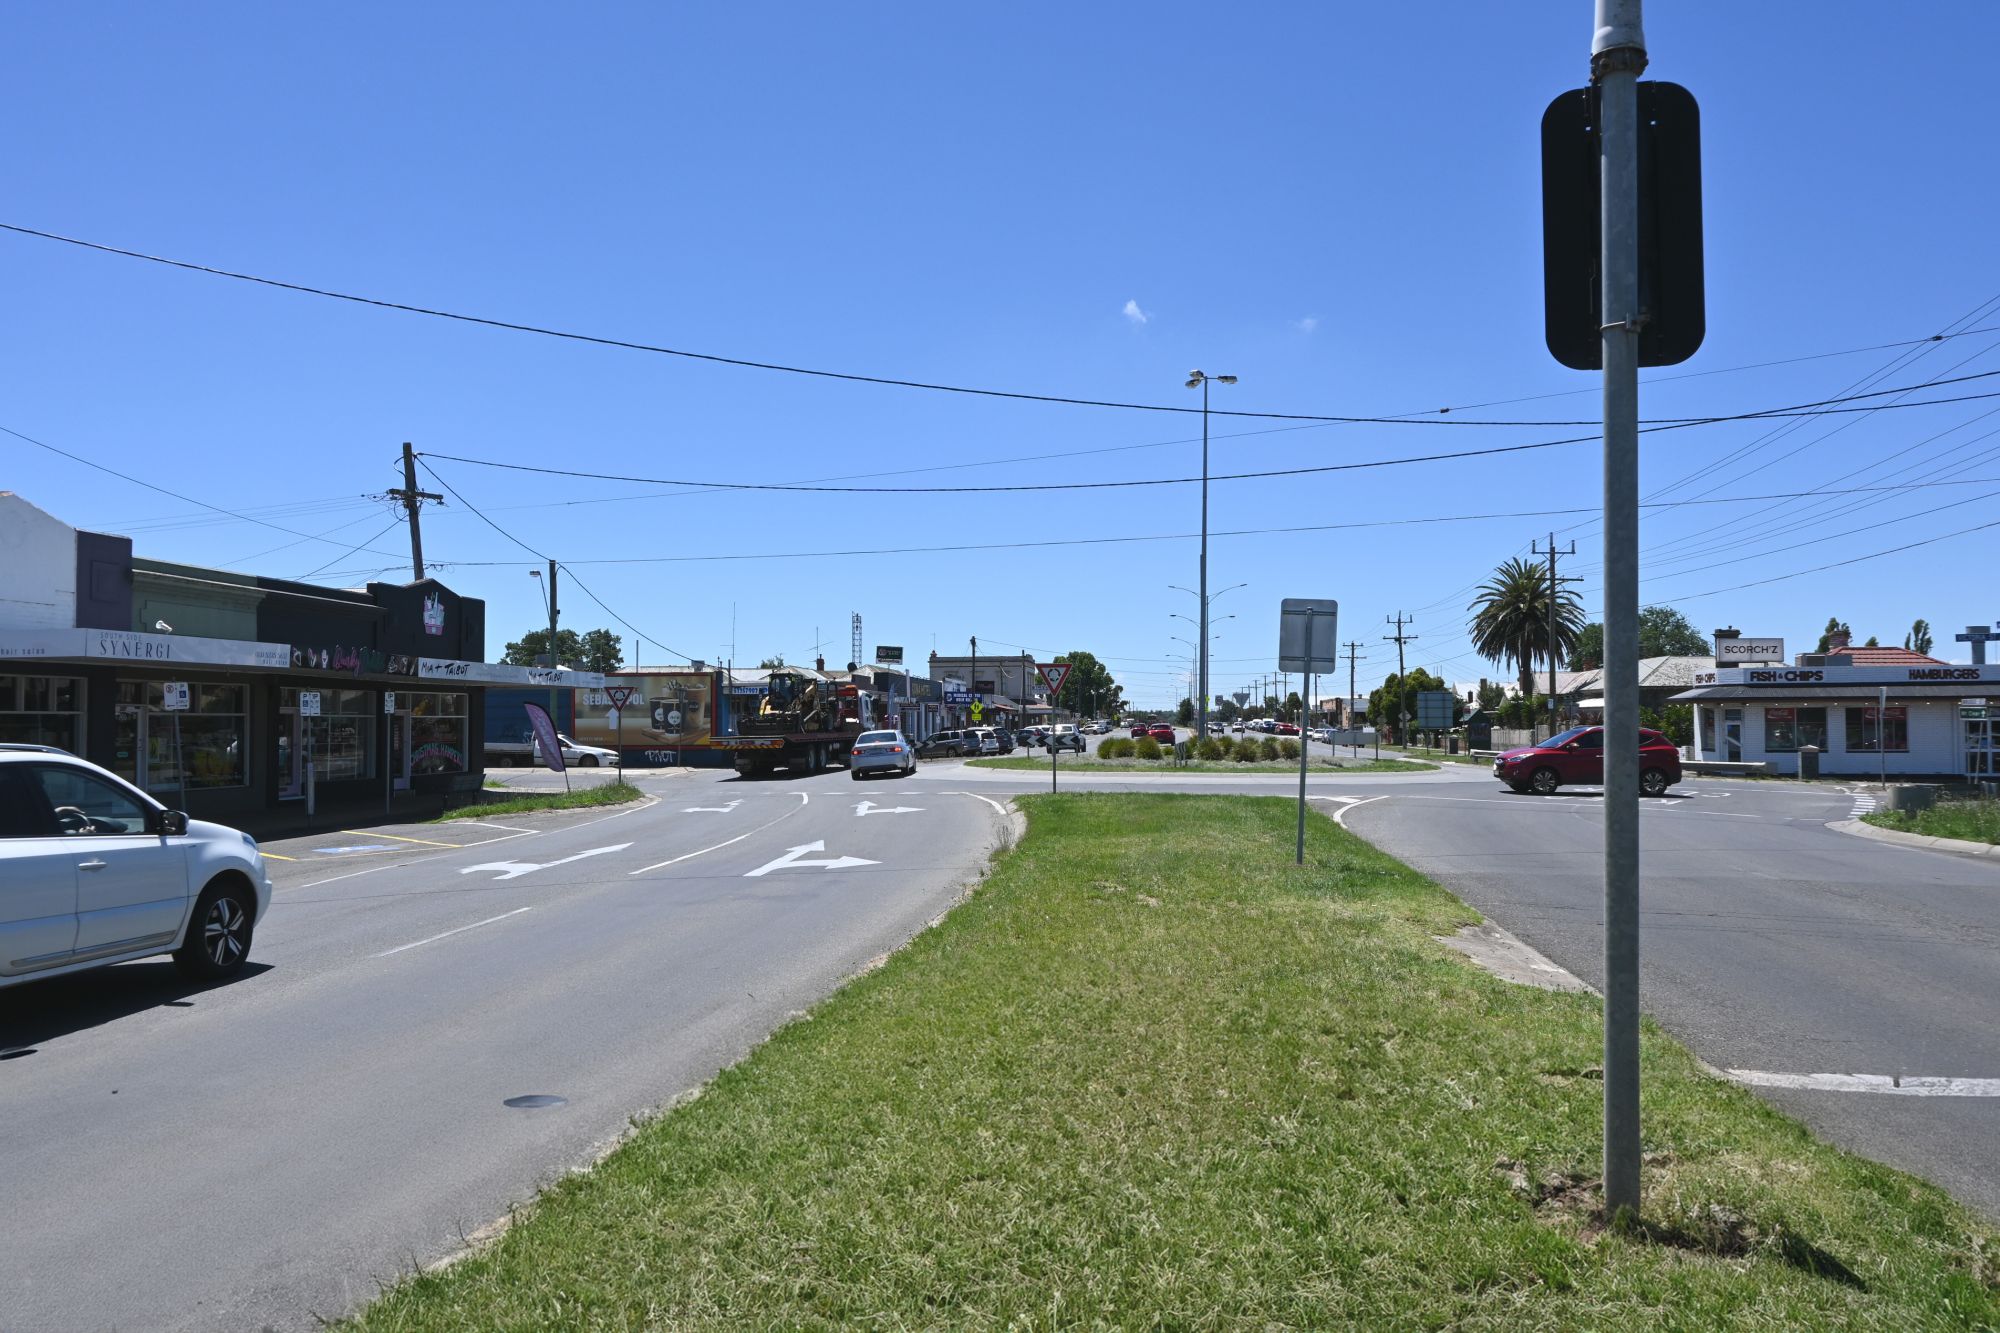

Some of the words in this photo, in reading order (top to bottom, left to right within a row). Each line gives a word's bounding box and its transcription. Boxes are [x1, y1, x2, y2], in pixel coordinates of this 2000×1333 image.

[100, 640, 170, 659] SYNERGI
[1724, 645, 1778, 654] SCORCH'Z
[1750, 671, 1776, 681] FISH
[1784, 671, 1823, 681] CHIPS
[1909, 669, 1980, 680] HAMBURGERS
